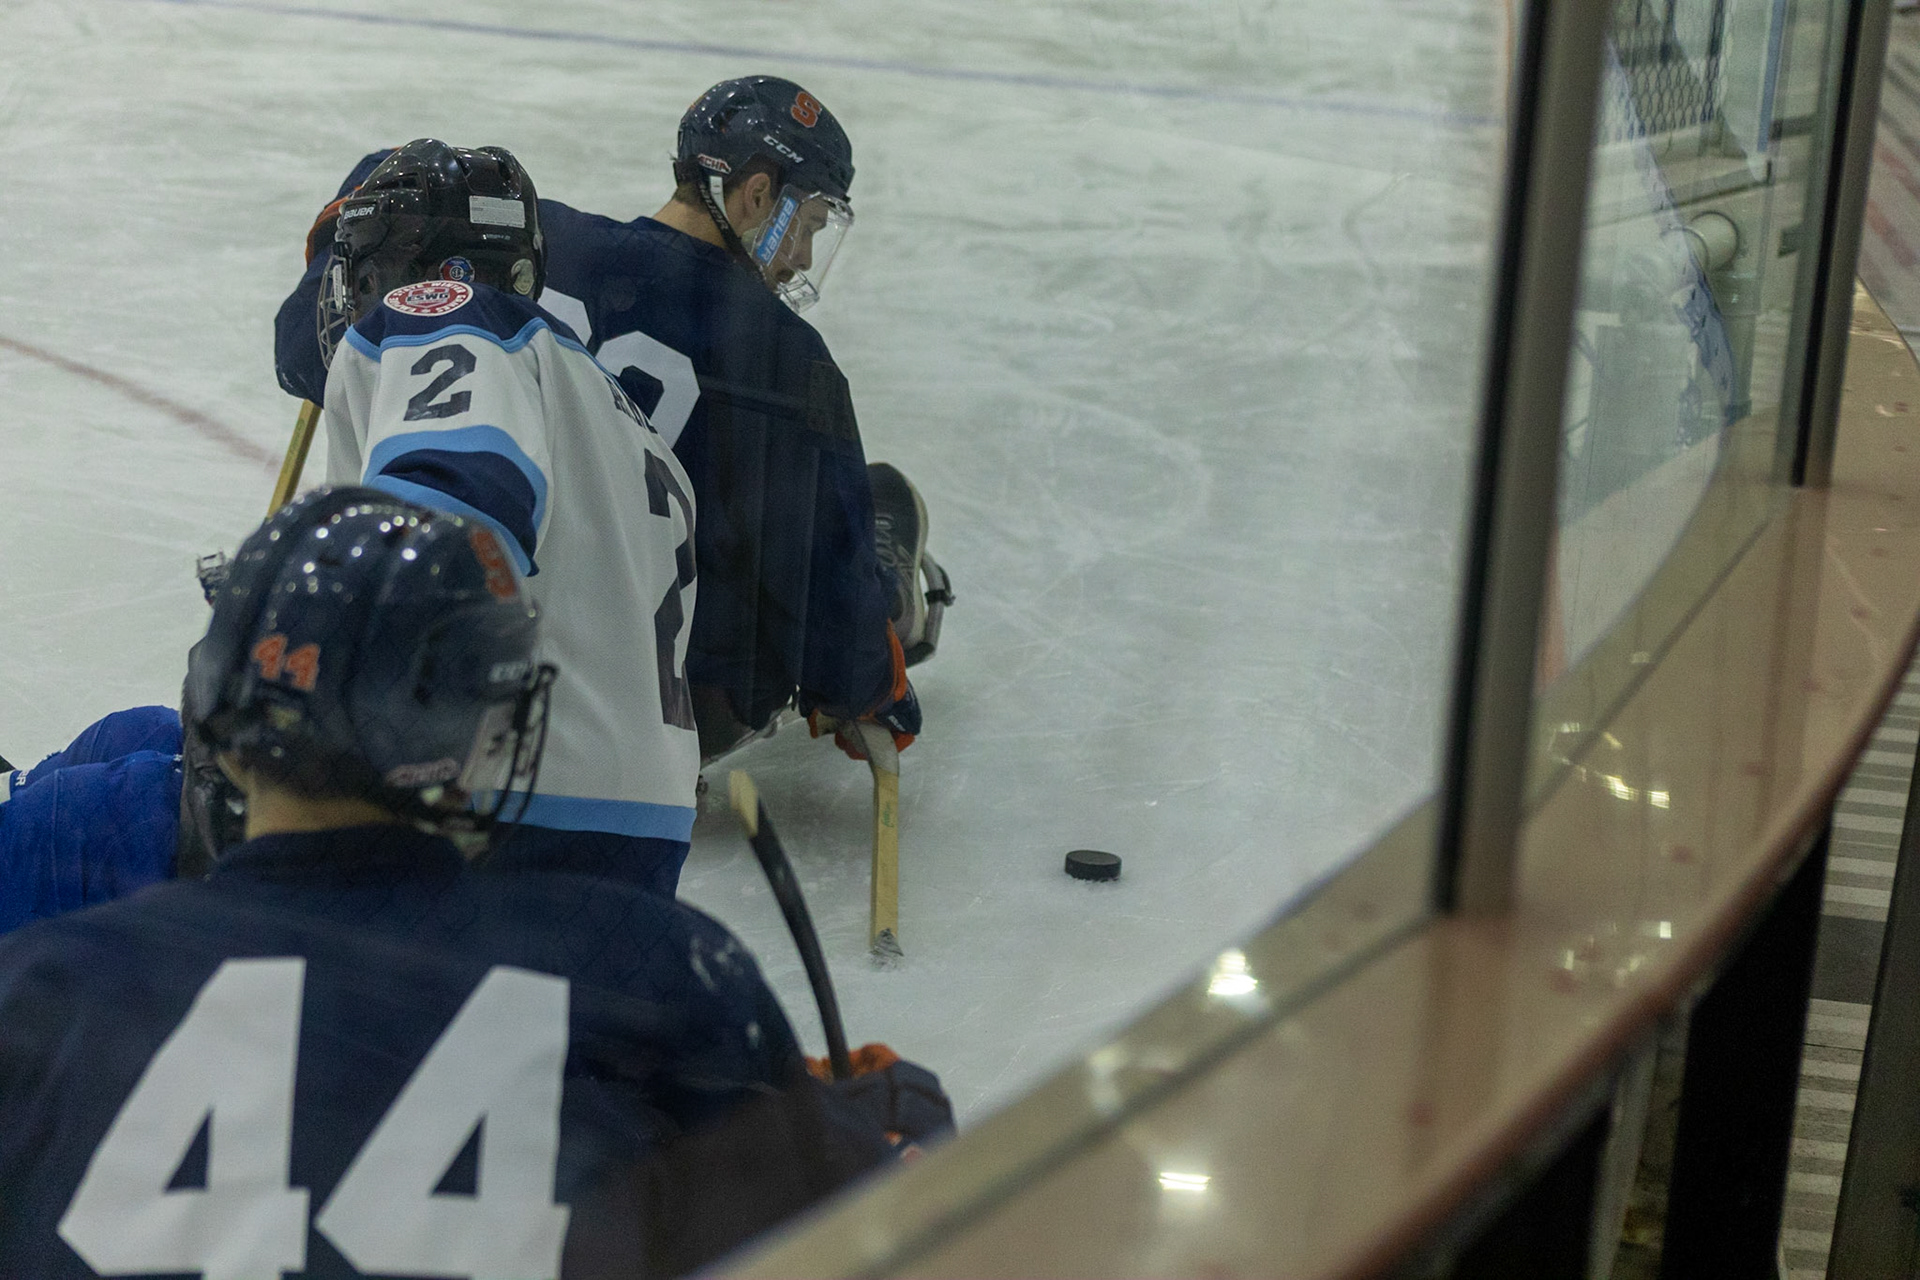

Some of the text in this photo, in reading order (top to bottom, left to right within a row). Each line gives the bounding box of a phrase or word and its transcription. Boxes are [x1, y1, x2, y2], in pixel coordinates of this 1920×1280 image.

[791, 91, 822, 128] S
[763, 134, 803, 163] CCM
[761, 199, 795, 262] BAUER
[404, 343, 477, 421] 2
[254, 633, 321, 692] 44
[57, 956, 572, 1280] 44
